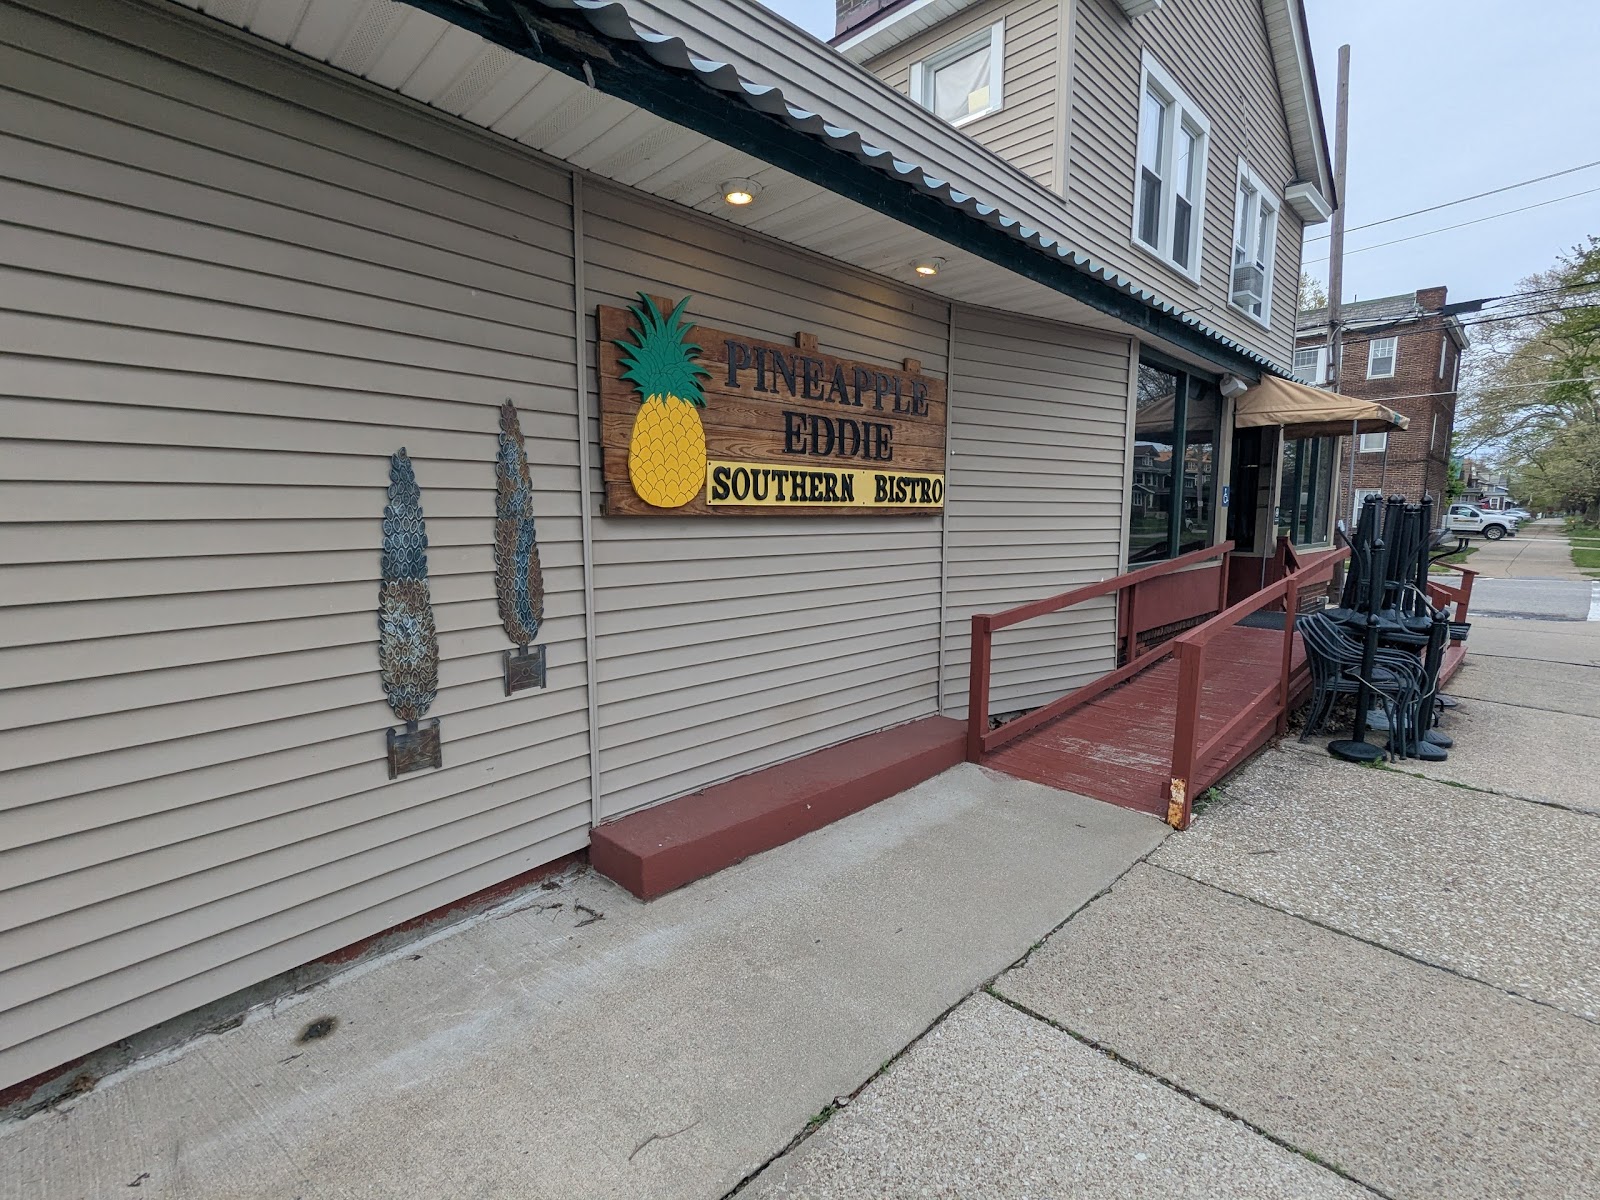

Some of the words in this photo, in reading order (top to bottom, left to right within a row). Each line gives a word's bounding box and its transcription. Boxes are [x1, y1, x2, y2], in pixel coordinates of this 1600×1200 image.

[724, 339, 929, 417] PINEAPPLE
[781, 411, 894, 461] EDDIE
[711, 466, 855, 503] SOUTHERN
[874, 474, 943, 503] BISTRO
